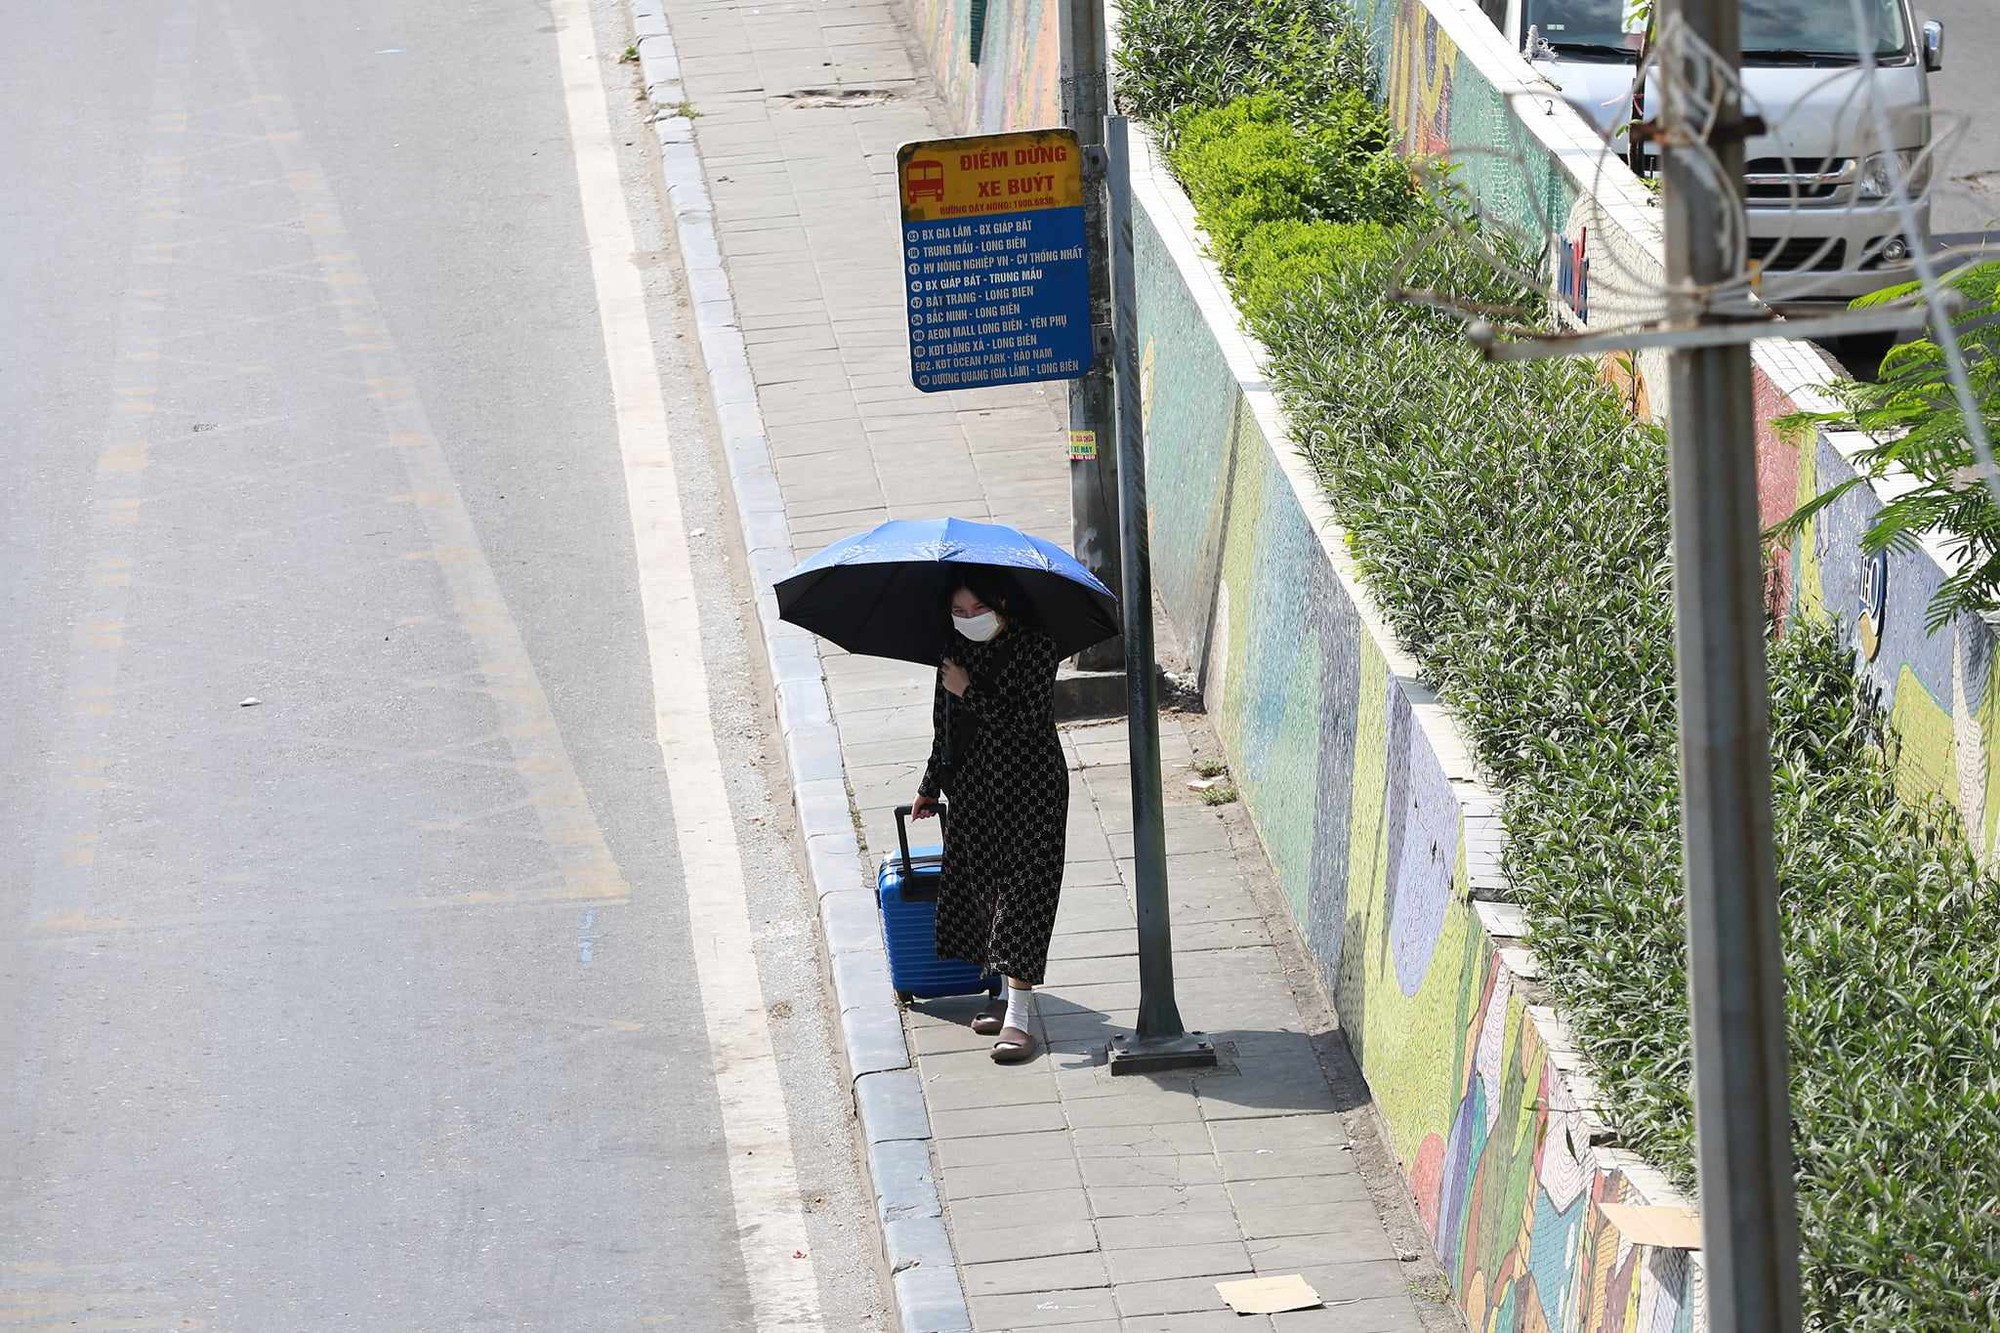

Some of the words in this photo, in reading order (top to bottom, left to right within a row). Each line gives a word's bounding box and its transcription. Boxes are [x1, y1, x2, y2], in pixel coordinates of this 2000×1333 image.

[960, 147, 1008, 170] ĐIỂM
[1015, 144, 1066, 166] DỪNG
[978, 180, 1001, 197] XE
[1008, 172, 1054, 195] BUÝT
[922, 229, 934, 240] BX
[936, 228, 950, 239] GIA
[979, 224, 991, 235] BX
[993, 220, 1013, 234] GIÁP
[1016, 218, 1032, 232] BÁT
[923, 245, 951, 257] TRUNG
[982, 240, 1003, 252] LONG
[1006, 236, 1026, 250] BIÊN
[924, 263, 934, 274] HV
[997, 255, 1008, 266] VN
[1017, 252, 1028, 264] CV
[1060, 244, 1083, 260] NHẤT
[925, 280, 938, 291] BX
[940, 275, 961, 289] GIÁP
[964, 273, 981, 286] BÁT
[989, 271, 1019, 284] TRUNG
[985, 288, 1009, 300] LONG
[946, 309, 967, 322] NINH
[976, 307, 997, 318] LONG
[928, 328, 950, 340] AEON
[953, 325, 975, 338] MALL
[978, 322, 1000, 335] LONG
[1002, 318, 1022, 332] BIÊN
[1030, 315, 1047, 328] YÊN
[1050, 314, 1067, 327] PHỤ
[928, 344, 945, 357] KĐT
[992, 337, 1014, 349] LONG
[954, 356, 981, 368] OCEAN
[983, 353, 1006, 364] PARK
[1032, 348, 1053, 359] NAM
[962, 370, 988, 383] QUANG
[991, 368, 1007, 380] (GIA
[1037, 362, 1058, 374] LONG
